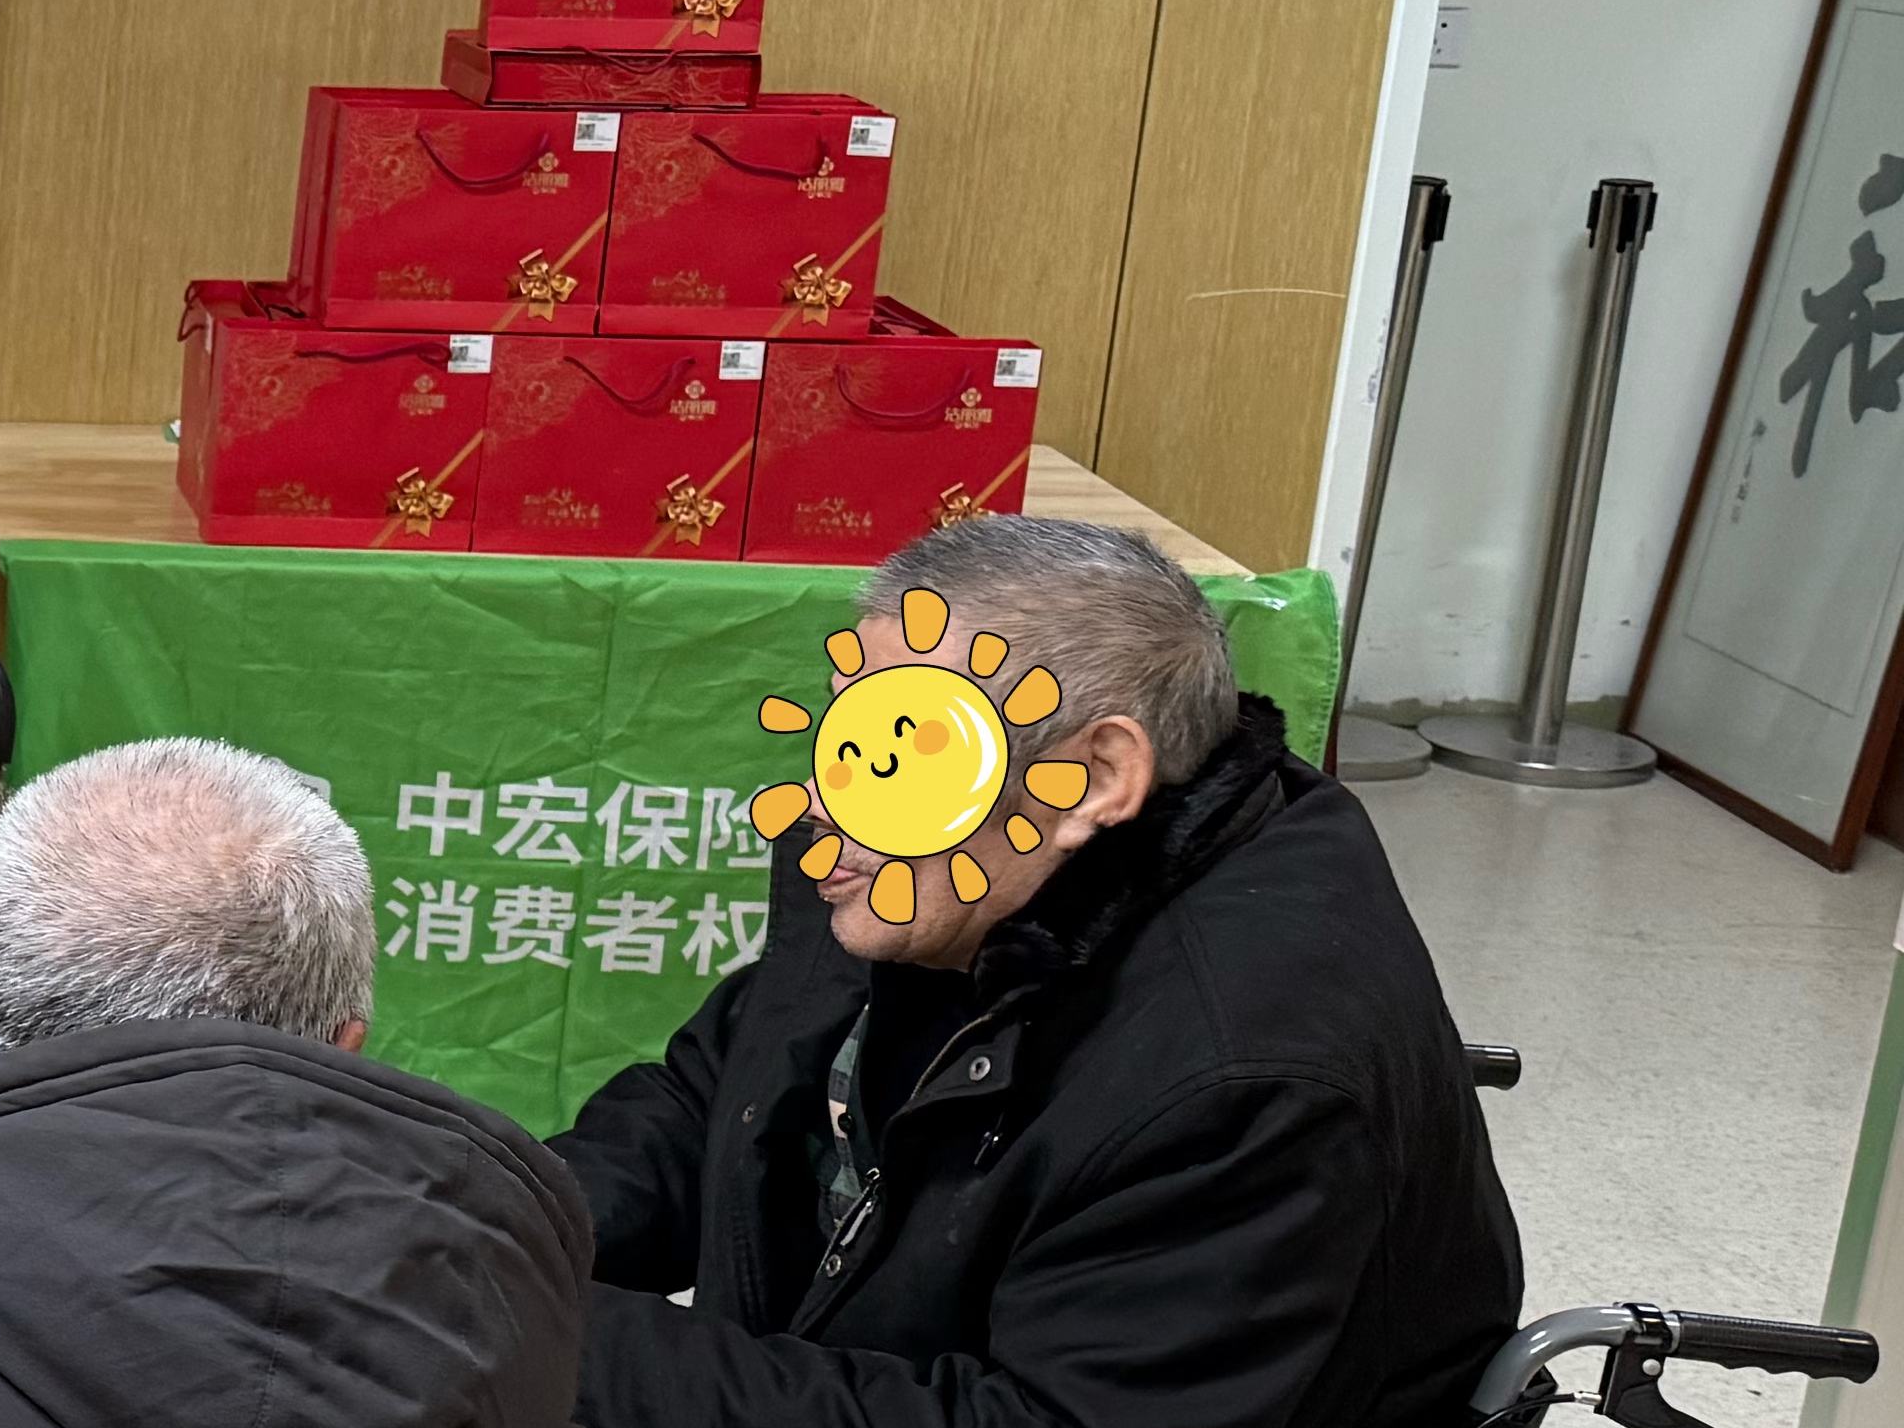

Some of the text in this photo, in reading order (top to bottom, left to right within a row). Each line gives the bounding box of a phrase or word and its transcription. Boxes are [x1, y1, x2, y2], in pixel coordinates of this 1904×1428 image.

[396, 771, 773, 872] 中宏保险
[383, 876, 770, 977] 消费者权
